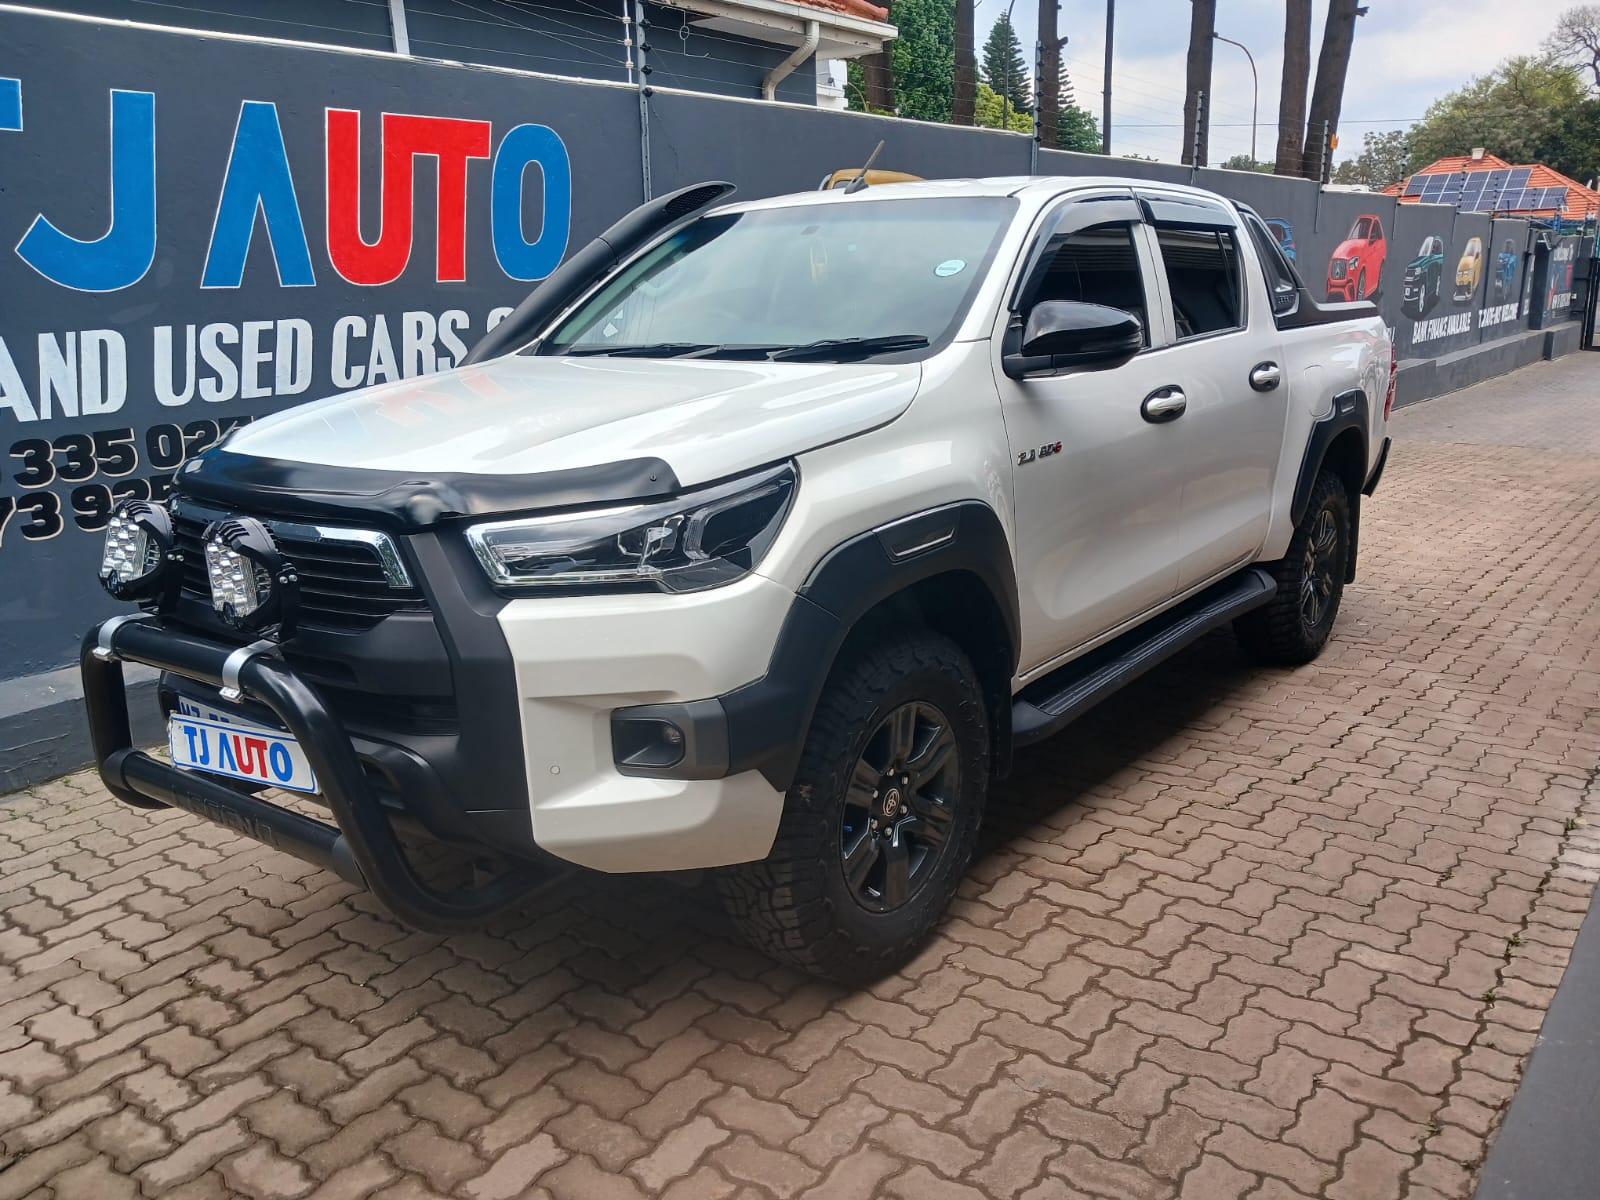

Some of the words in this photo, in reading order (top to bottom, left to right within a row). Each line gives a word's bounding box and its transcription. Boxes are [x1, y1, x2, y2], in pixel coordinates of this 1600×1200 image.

[200, 100, 572, 289] AUTO
[153, 319, 313, 405] USED
[331, 309, 470, 388] CARS
[9, 427, 138, 489] 335
[183, 725, 210, 766] TJ
[218, 732, 293, 782] AUTO
